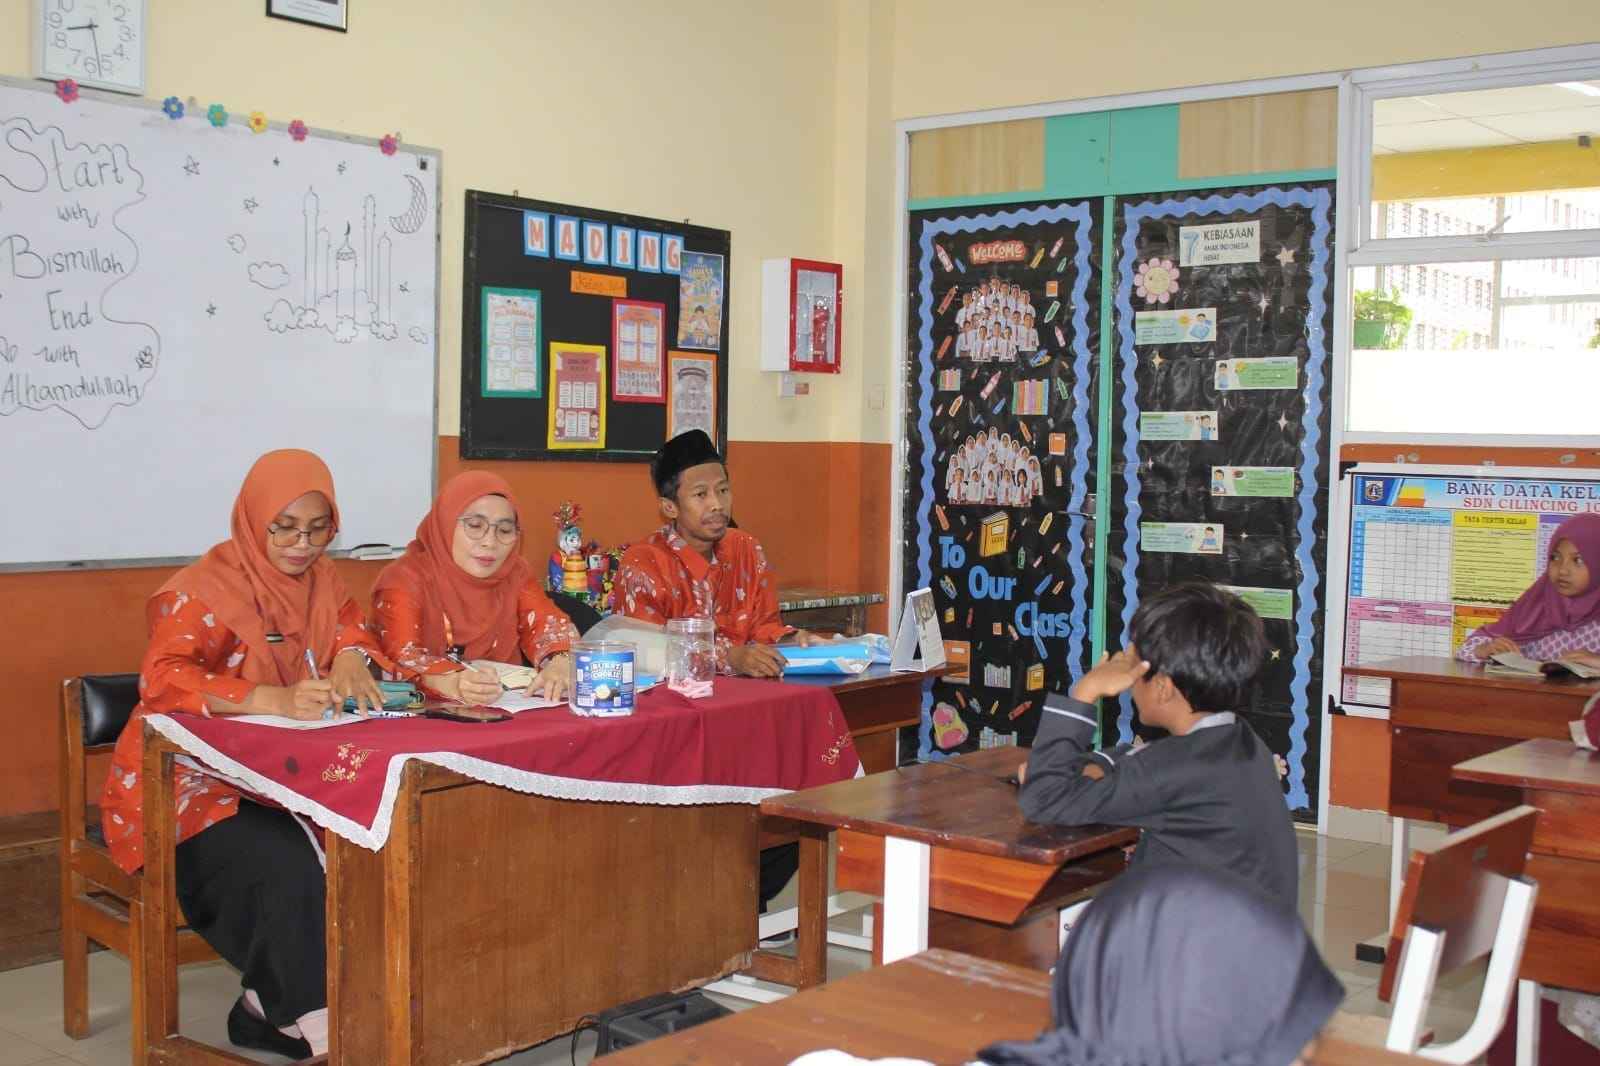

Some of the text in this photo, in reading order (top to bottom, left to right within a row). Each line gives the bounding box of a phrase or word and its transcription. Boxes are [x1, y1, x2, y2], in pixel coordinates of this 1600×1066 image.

[48, 11, 63, 29] 9
[113, 4, 127, 22] 2
[55, 31, 67, 49] 8
[119, 25, 132, 41] 3
[69, 46, 81, 65] 7
[113, 43, 124, 60] 4
[83, 55, 97, 74] 6
[0, 127, 124, 192] Start
[56, 200, 100, 229] with
[1203, 226, 1255, 241] KEBIASAAN
[0, 234, 125, 280] Bismillah
[1182, 231, 1201, 264] 7
[46, 289, 93, 331] End
[33, 344, 81, 369] with
[1447, 482, 1600, 500] BANK DATA KEL
[1463, 497, 1493, 508] SDN
[1498, 499, 1578, 512] CILINCING
[938, 535, 966, 569] To
[968, 565, 1017, 600] Our
